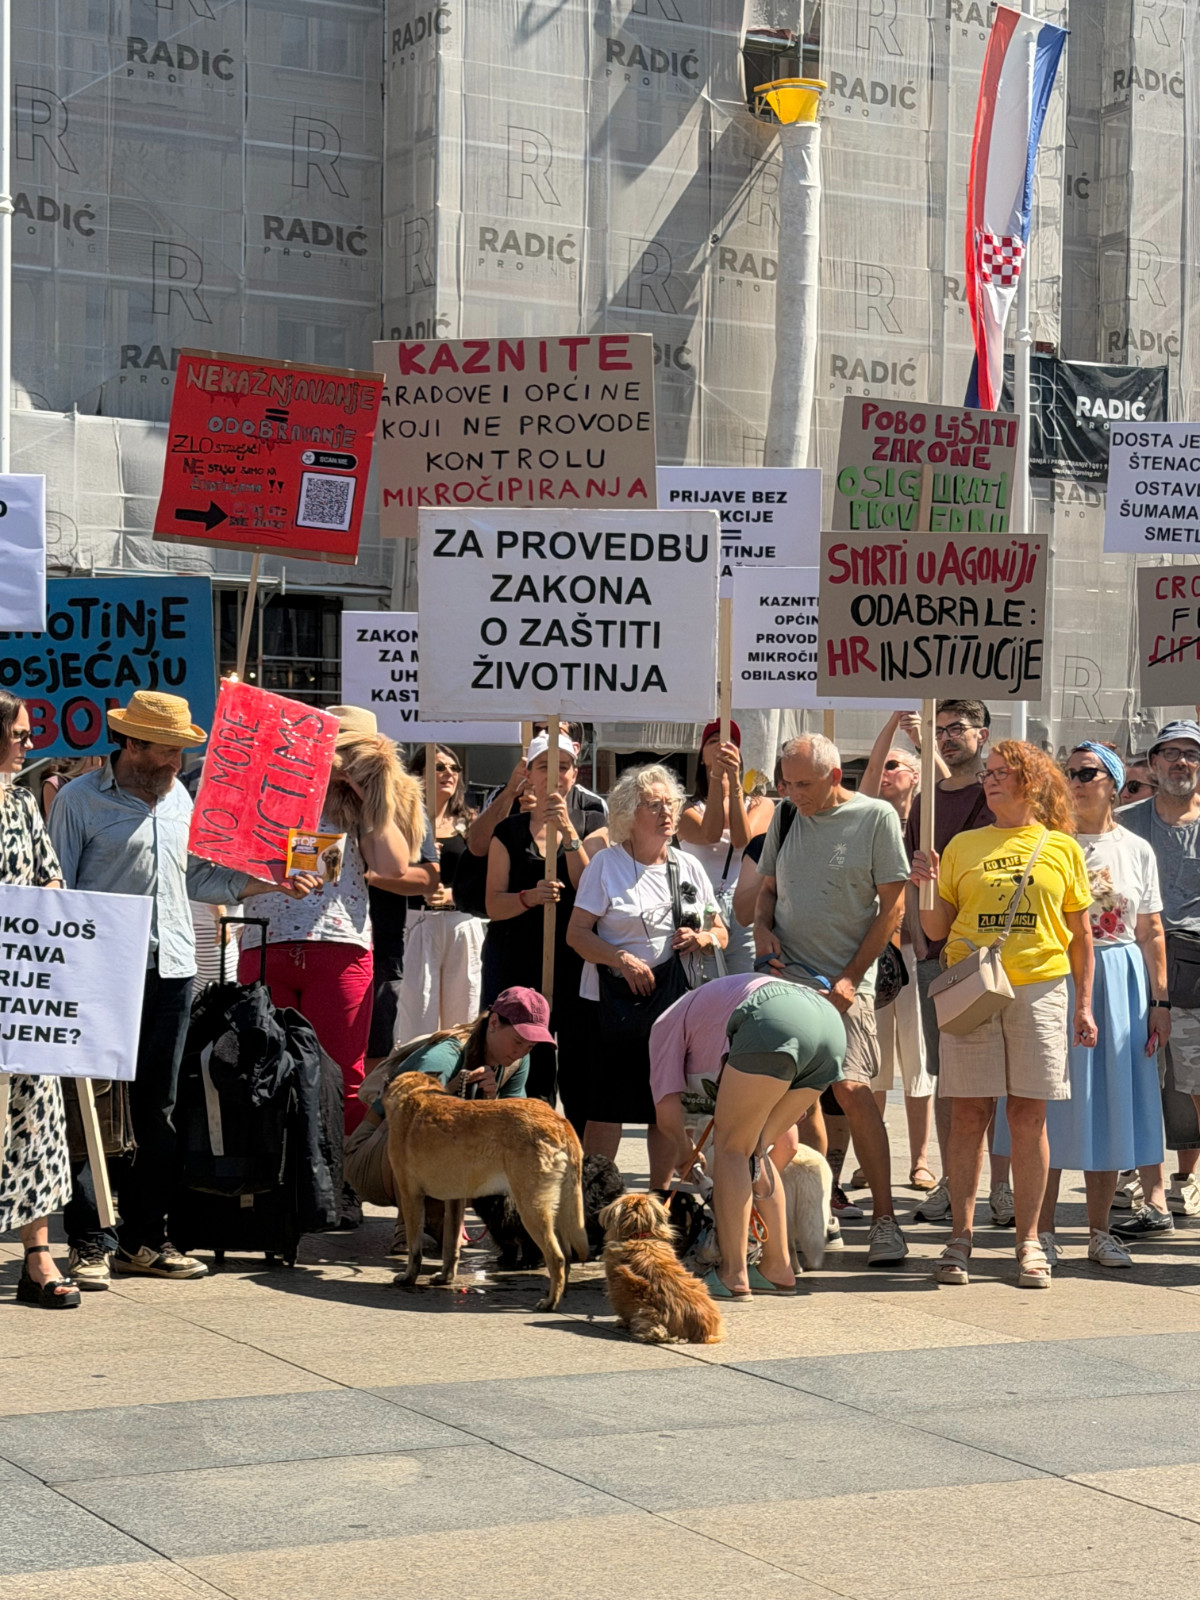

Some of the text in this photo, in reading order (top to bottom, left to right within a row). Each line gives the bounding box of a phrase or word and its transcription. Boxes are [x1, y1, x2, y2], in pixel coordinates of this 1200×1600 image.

[392, 2, 452, 55] RADIĆ
[127, 36, 234, 81] RADIĆ
[606, 38, 699, 80] RADIĆ
[830, 71, 917, 110] RADIĆ
[1113, 66, 1185, 99] RADIĆ
[263, 214, 368, 256] RADIĆ
[479, 226, 577, 265] RADIĆ
[398, 335, 632, 375] KAZNITE
[1108, 327, 1180, 357] RADIĆ
[830, 354, 917, 386] RADIĆ
[502, 385, 509, 404] I
[524, 376, 640, 404] OPĆINE
[1075, 396, 1146, 421] RADIĆ
[381, 411, 651, 440] KOJI NE PROVODE
[1112, 432, 1173, 449] DOSTA
[426, 449, 605, 472] KONTROLU
[872, 436, 992, 470] ZAKONE
[383, 475, 648, 507] MIKROČIPIRANJA
[670, 490, 787, 503] PRIJAVE BEZ
[433, 529, 709, 563] ZA PROVEDBU
[491, 574, 653, 606] ZAKONA
[759, 596, 819, 607] KAZNIT
[480, 612, 662, 649] O ZAŠTITI
[756, 634, 817, 644] PROVOD
[379, 650, 404, 662] ZA
[827, 636, 878, 677] HR
[471, 654, 668, 693] ŽIVOTINJA
[0, 915, 96, 940] KO JOŠ
[0, 1023, 82, 1045] JENE?
